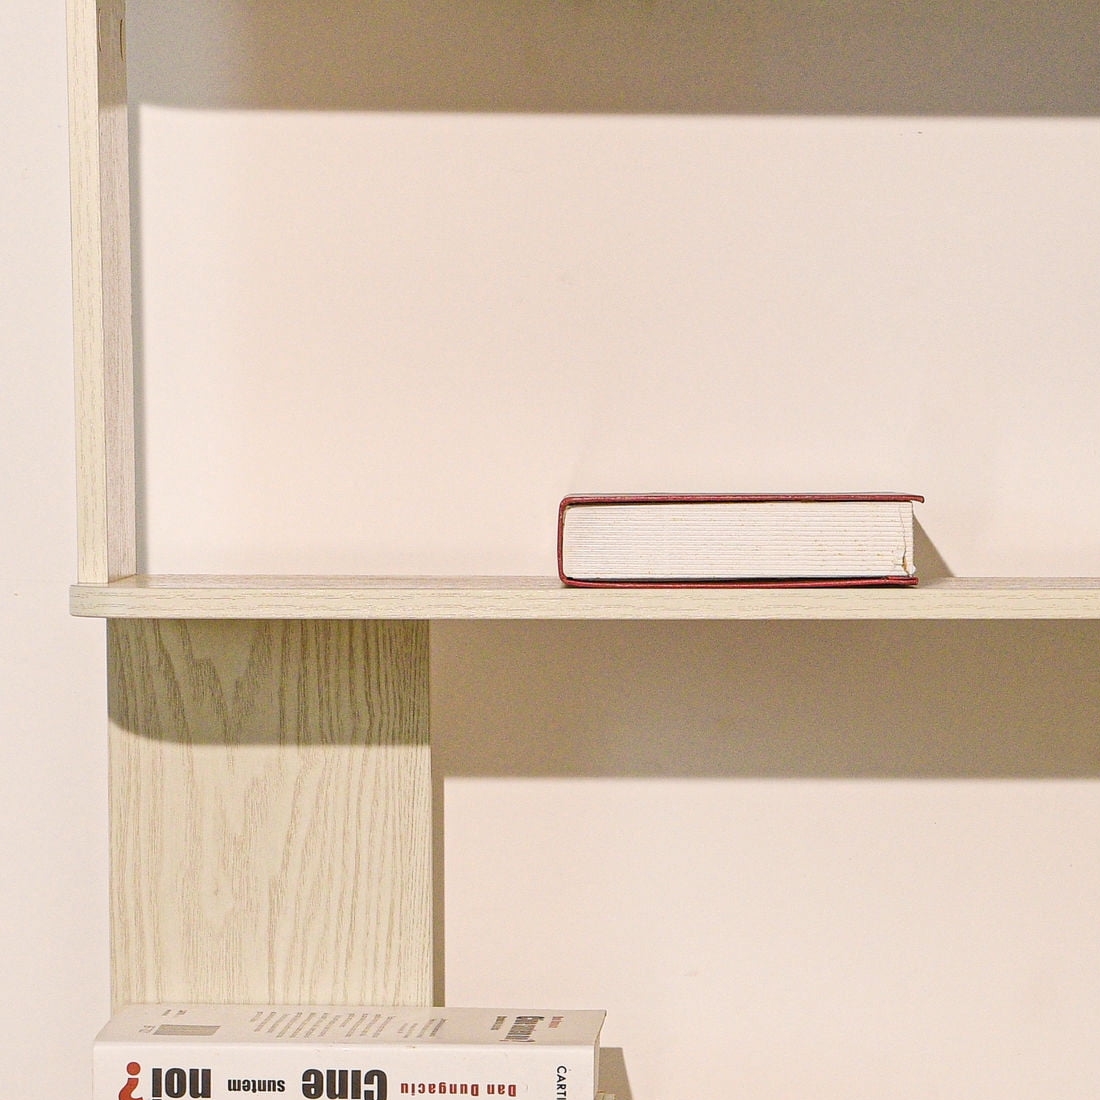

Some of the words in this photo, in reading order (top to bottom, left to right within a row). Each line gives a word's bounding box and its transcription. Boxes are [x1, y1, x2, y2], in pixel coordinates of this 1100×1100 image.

[227, 1078, 286, 1094] suntem
[400, 1081, 479, 1097] Dungaciu
[487, 1083, 517, 1097] Dan
